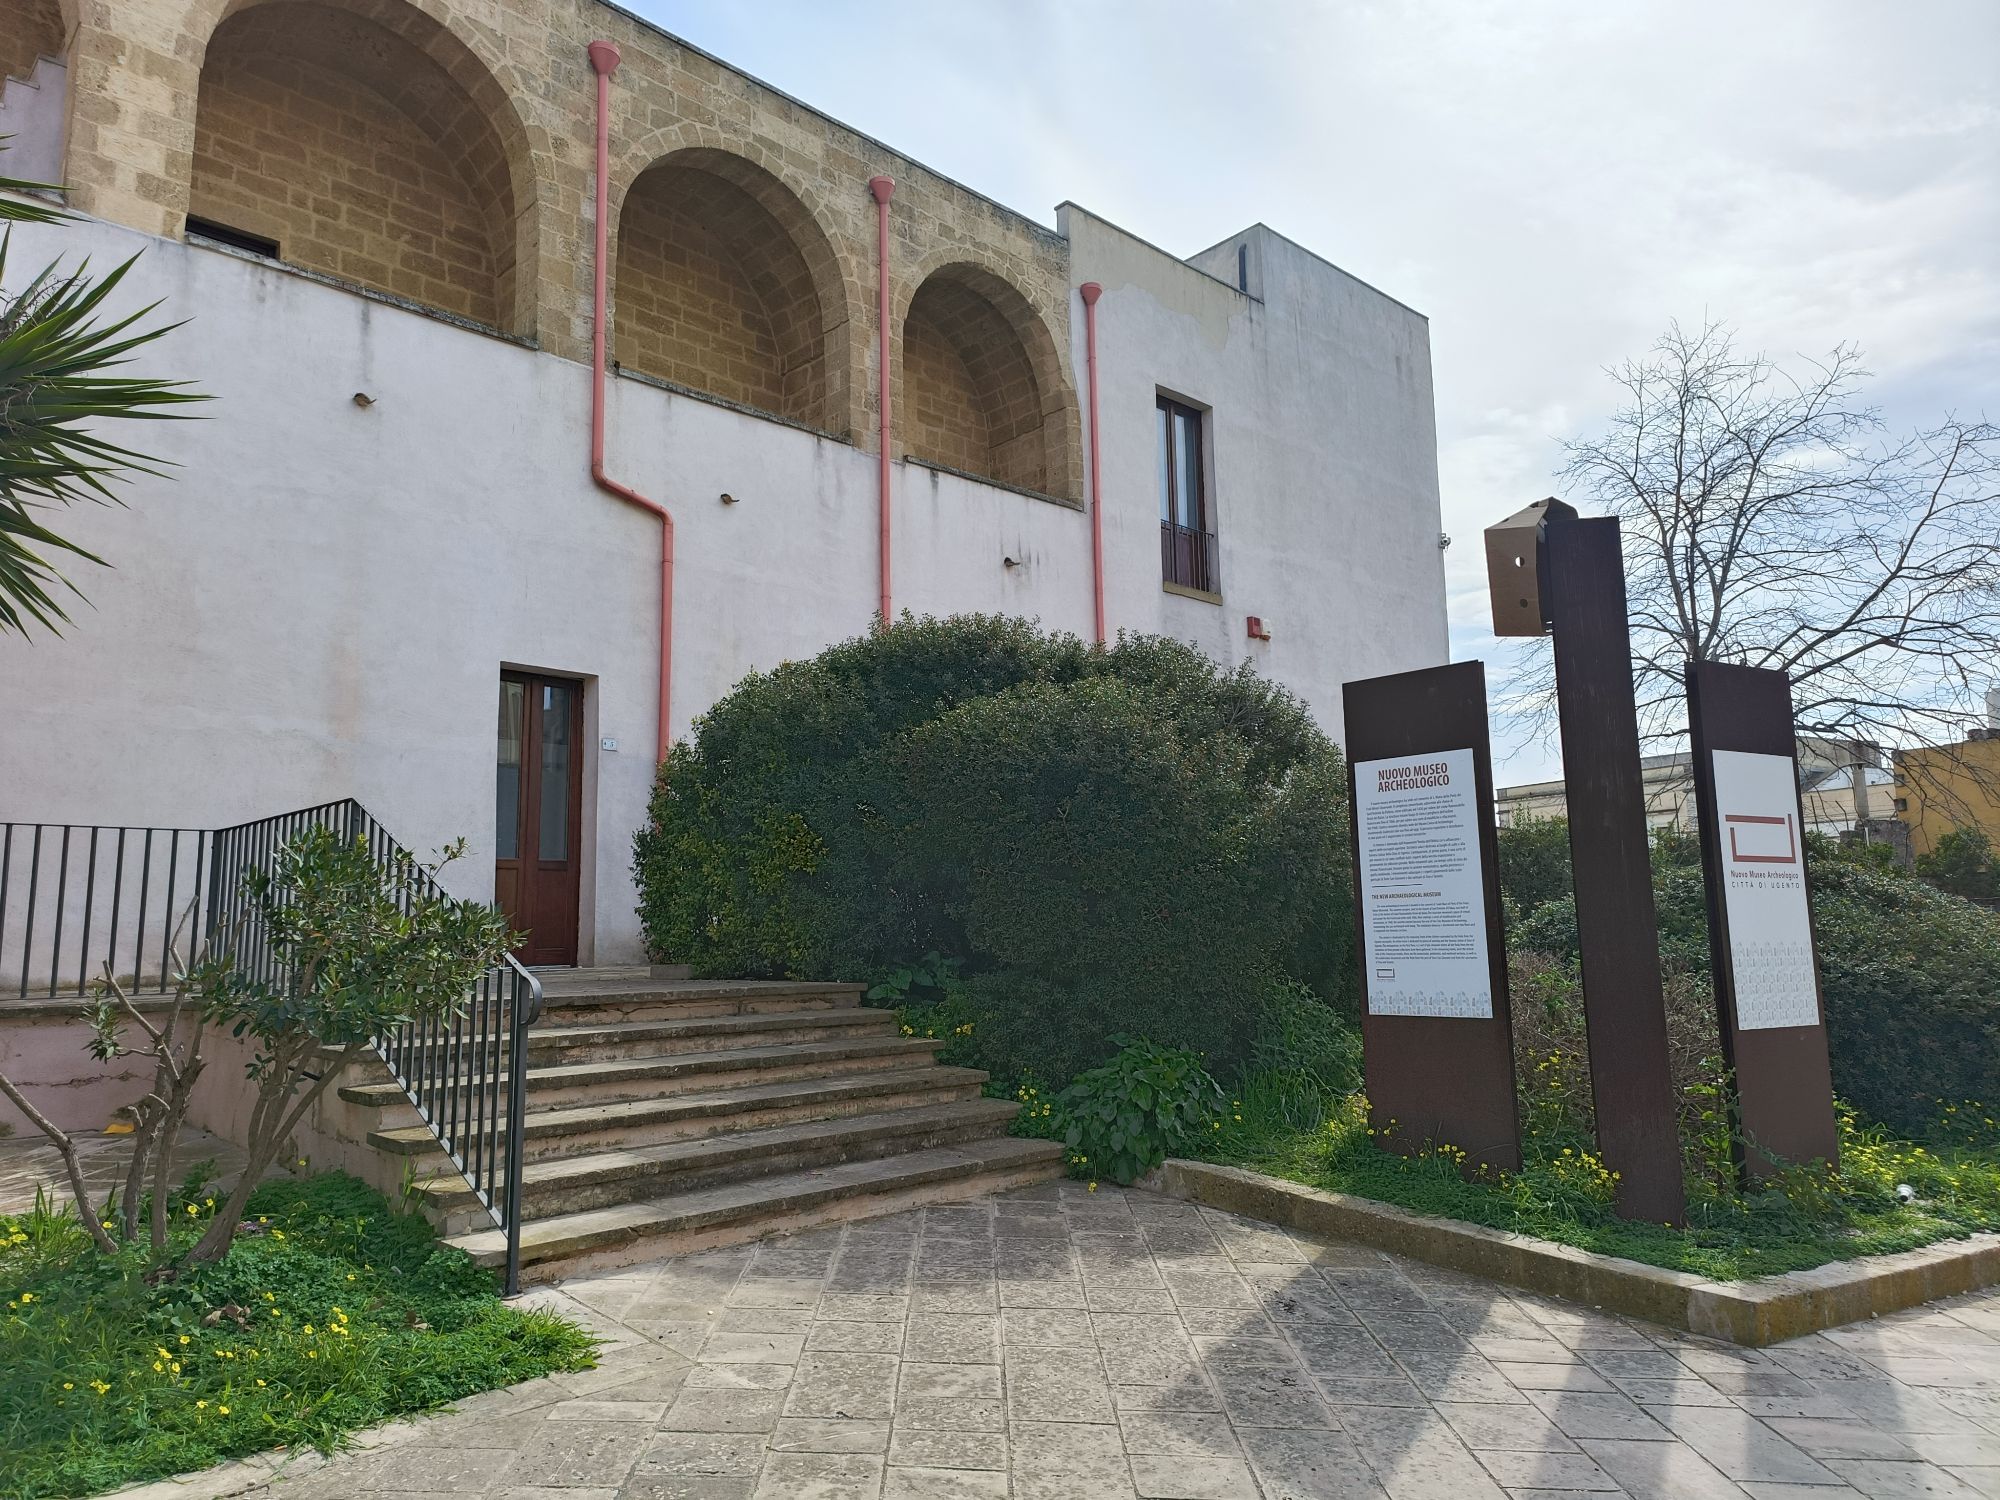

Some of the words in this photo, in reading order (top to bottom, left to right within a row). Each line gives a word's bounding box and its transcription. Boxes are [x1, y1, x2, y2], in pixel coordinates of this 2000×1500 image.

[1378, 767, 1411, 781] NUOVO
[1413, 762, 1448, 777] MUSEO
[1378, 774, 1450, 793] ARCHEOLOGICO
[1730, 870, 1748, 879] Nuovo
[1749, 870, 1766, 879] Museo
[1767, 870, 1799, 881] Archeologico
[1758, 881, 1767, 889] DI
